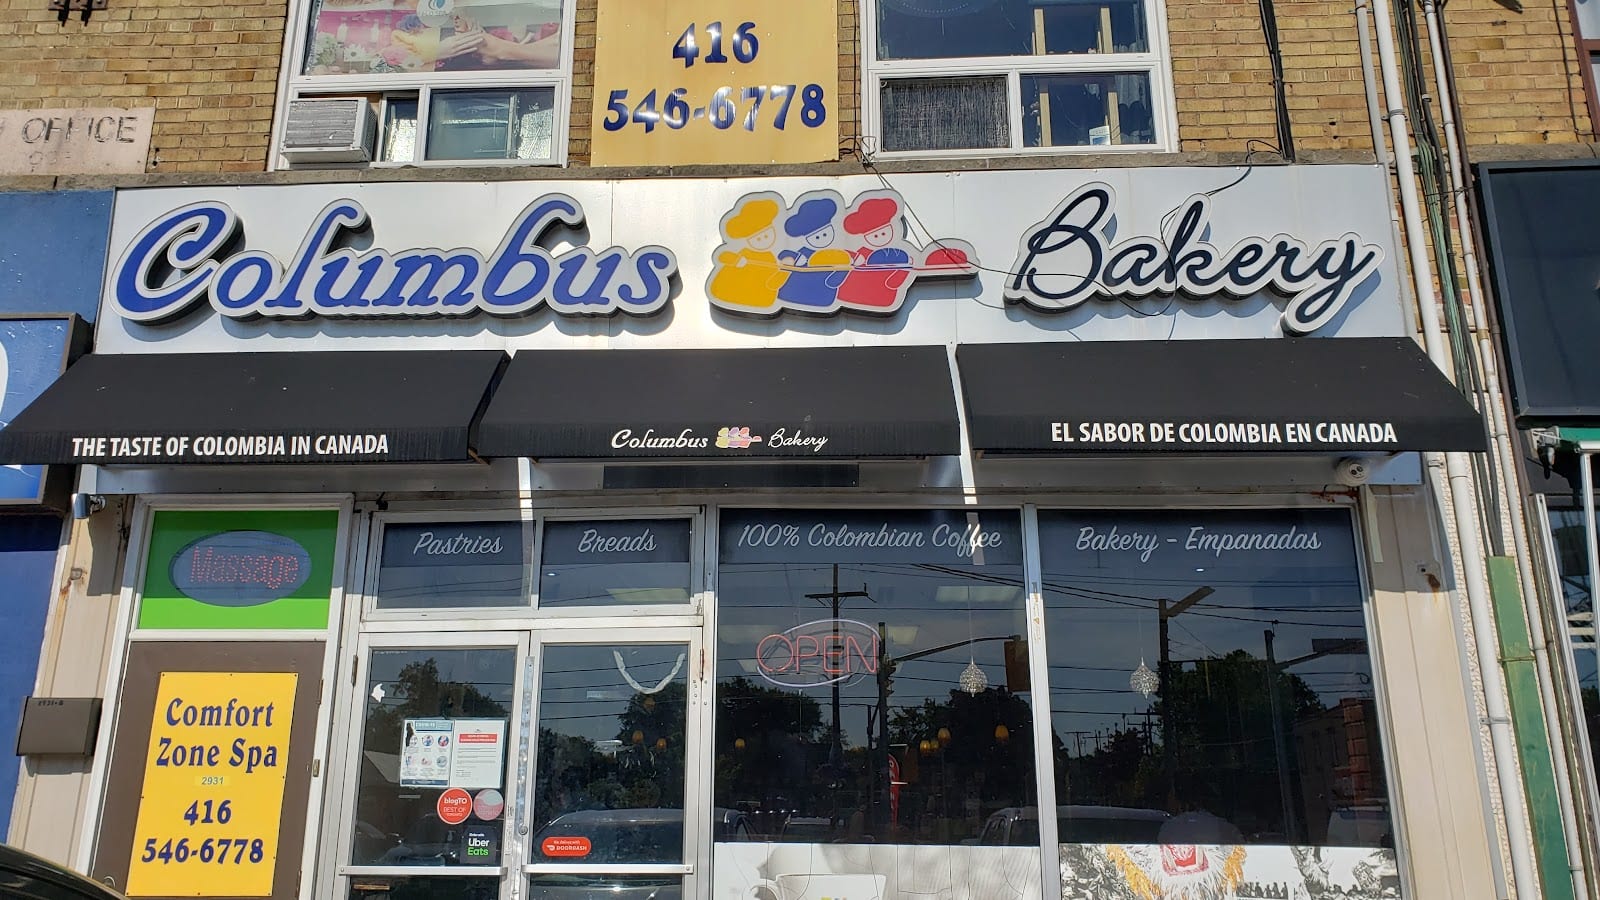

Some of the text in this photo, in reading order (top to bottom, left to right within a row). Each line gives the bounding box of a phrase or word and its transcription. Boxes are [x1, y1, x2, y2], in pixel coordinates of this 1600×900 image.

[672, 21, 759, 68] 416
[603, 83, 826, 134] 546-6778
[22, 116, 137, 144] OFFICE
[115, 189, 1376, 323] Columbus Bakery
[72, 434, 389, 456] THE TASTE OF COLOMBIA IN CANADA
[611, 427, 828, 452] Columbus Bakery
[1051, 423, 1398, 443] EL SABOR DE COLOMBIA EN CANADA
[413, 531, 503, 555] Pastries
[578, 528, 657, 553] Breads
[738, 522, 1002, 557] 100% Colombian Coffee
[1076, 525, 1159, 563] Bakery
[1185, 525, 1322, 558] Empanadas
[190, 546, 298, 589] Massage
[756, 633, 879, 673] OPEN
[166, 697, 274, 727] Comfort
[156, 737, 277, 773] Zone Spa
[201, 776, 224, 785] 2931
[184, 799, 232, 826] 416
[444, 797, 467, 806] blogTO
[141, 838, 264, 865] 546-6778
[467, 847, 489, 856] Eats
[468, 838, 490, 847] Uber
